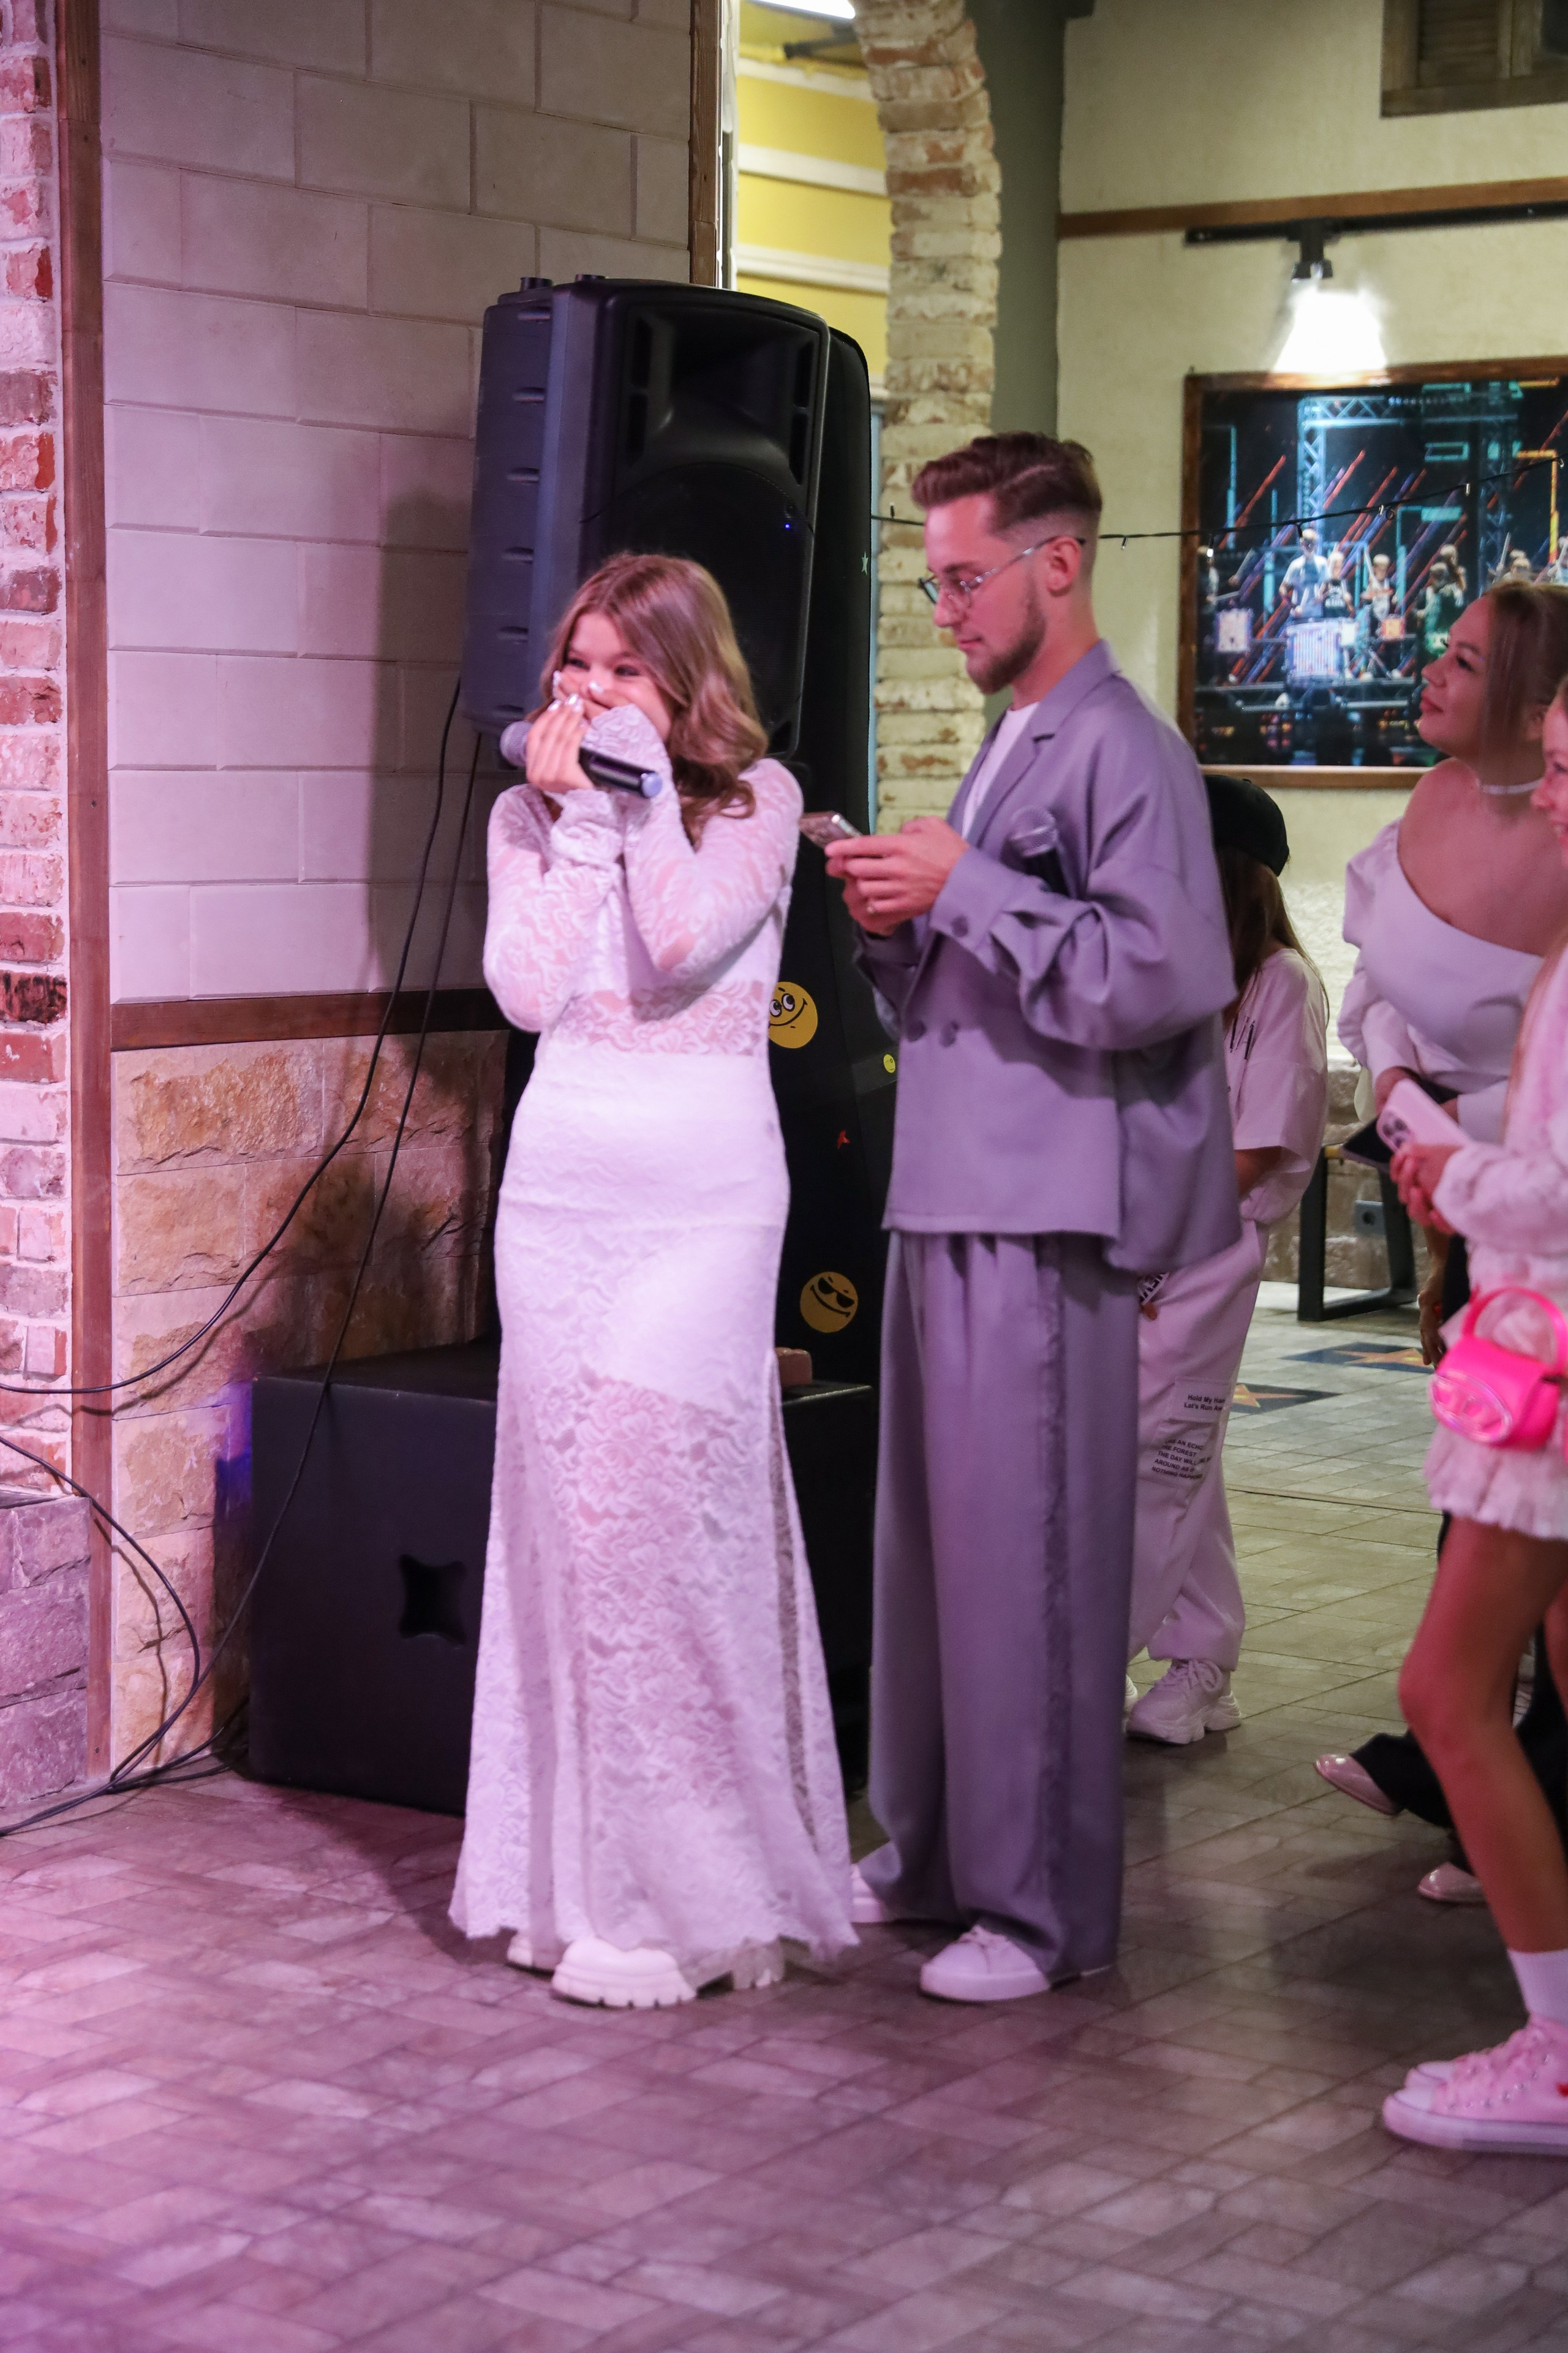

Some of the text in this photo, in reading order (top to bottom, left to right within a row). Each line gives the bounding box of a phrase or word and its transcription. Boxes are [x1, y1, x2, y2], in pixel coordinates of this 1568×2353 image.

[1173, 1446, 1197, 1457] FOREST
[1155, 1459, 1180, 1470] AROUND
[1152, 1466, 1178, 1476] NOTHING
